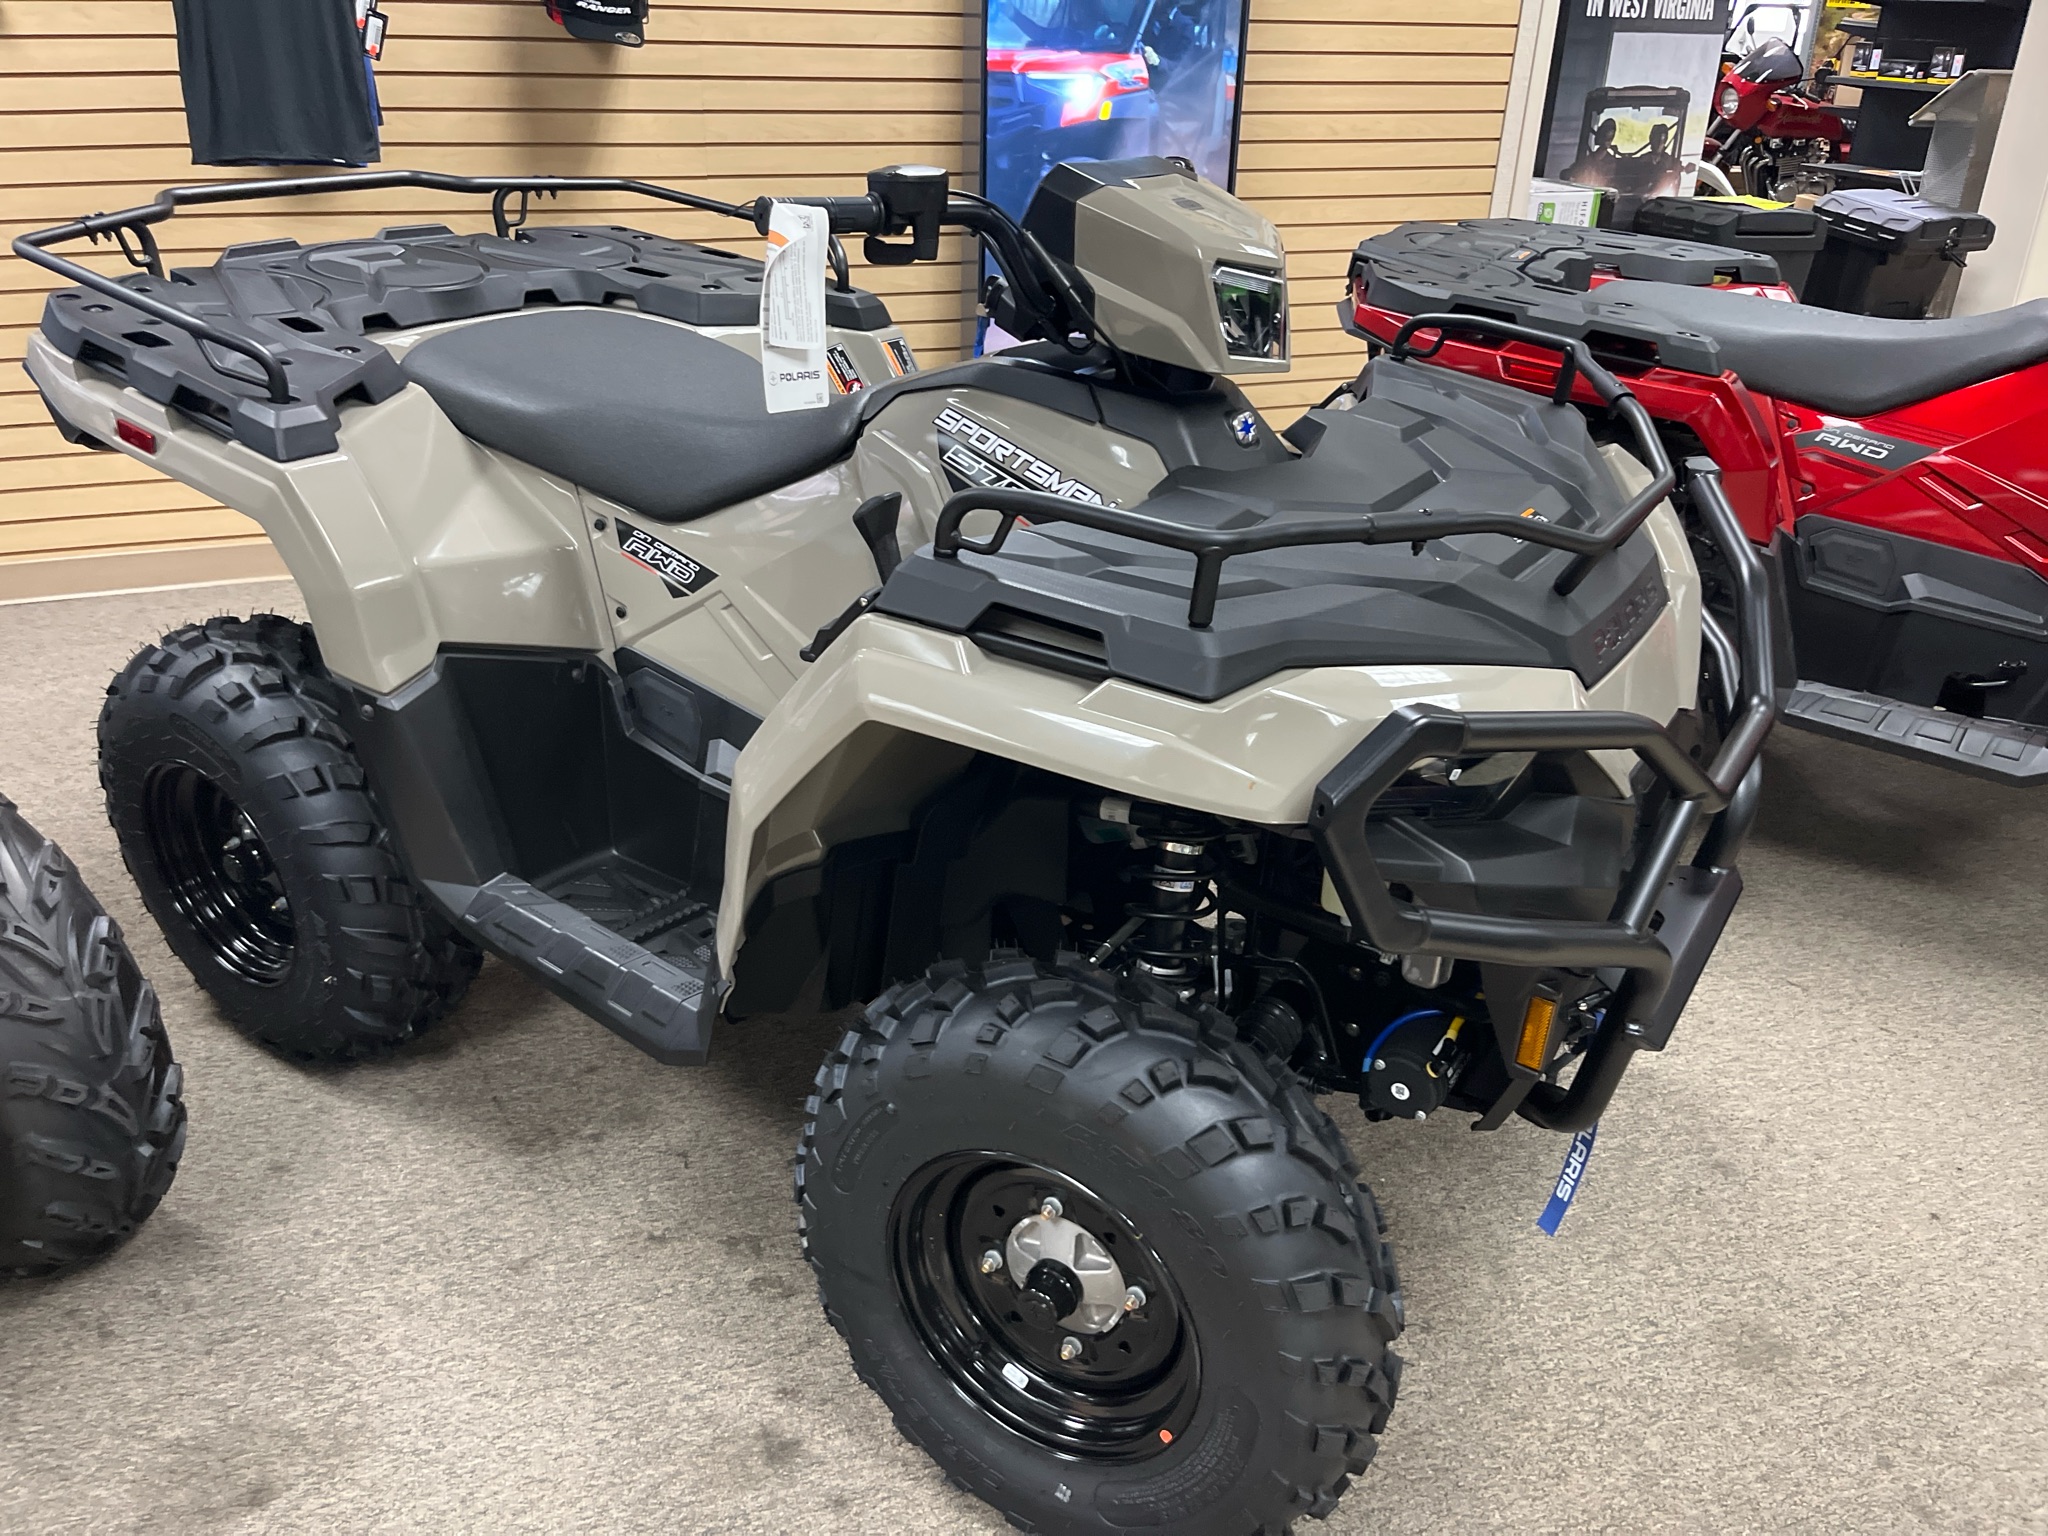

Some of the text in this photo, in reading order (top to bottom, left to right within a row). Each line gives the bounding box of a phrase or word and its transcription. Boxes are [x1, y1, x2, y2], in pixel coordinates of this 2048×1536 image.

[576, 1, 631, 14] RANGER
[1586, 0, 1715, 20] IN WEST VIRGINIA
[780, 371, 820, 382] POLARIS
[1814, 432, 1889, 459] AWD
[1843, 432, 1895, 450] DEMAND
[943, 444, 1032, 490] 57
[622, 537, 696, 584] AWD
[633, 530, 700, 572] ON DEMAND
